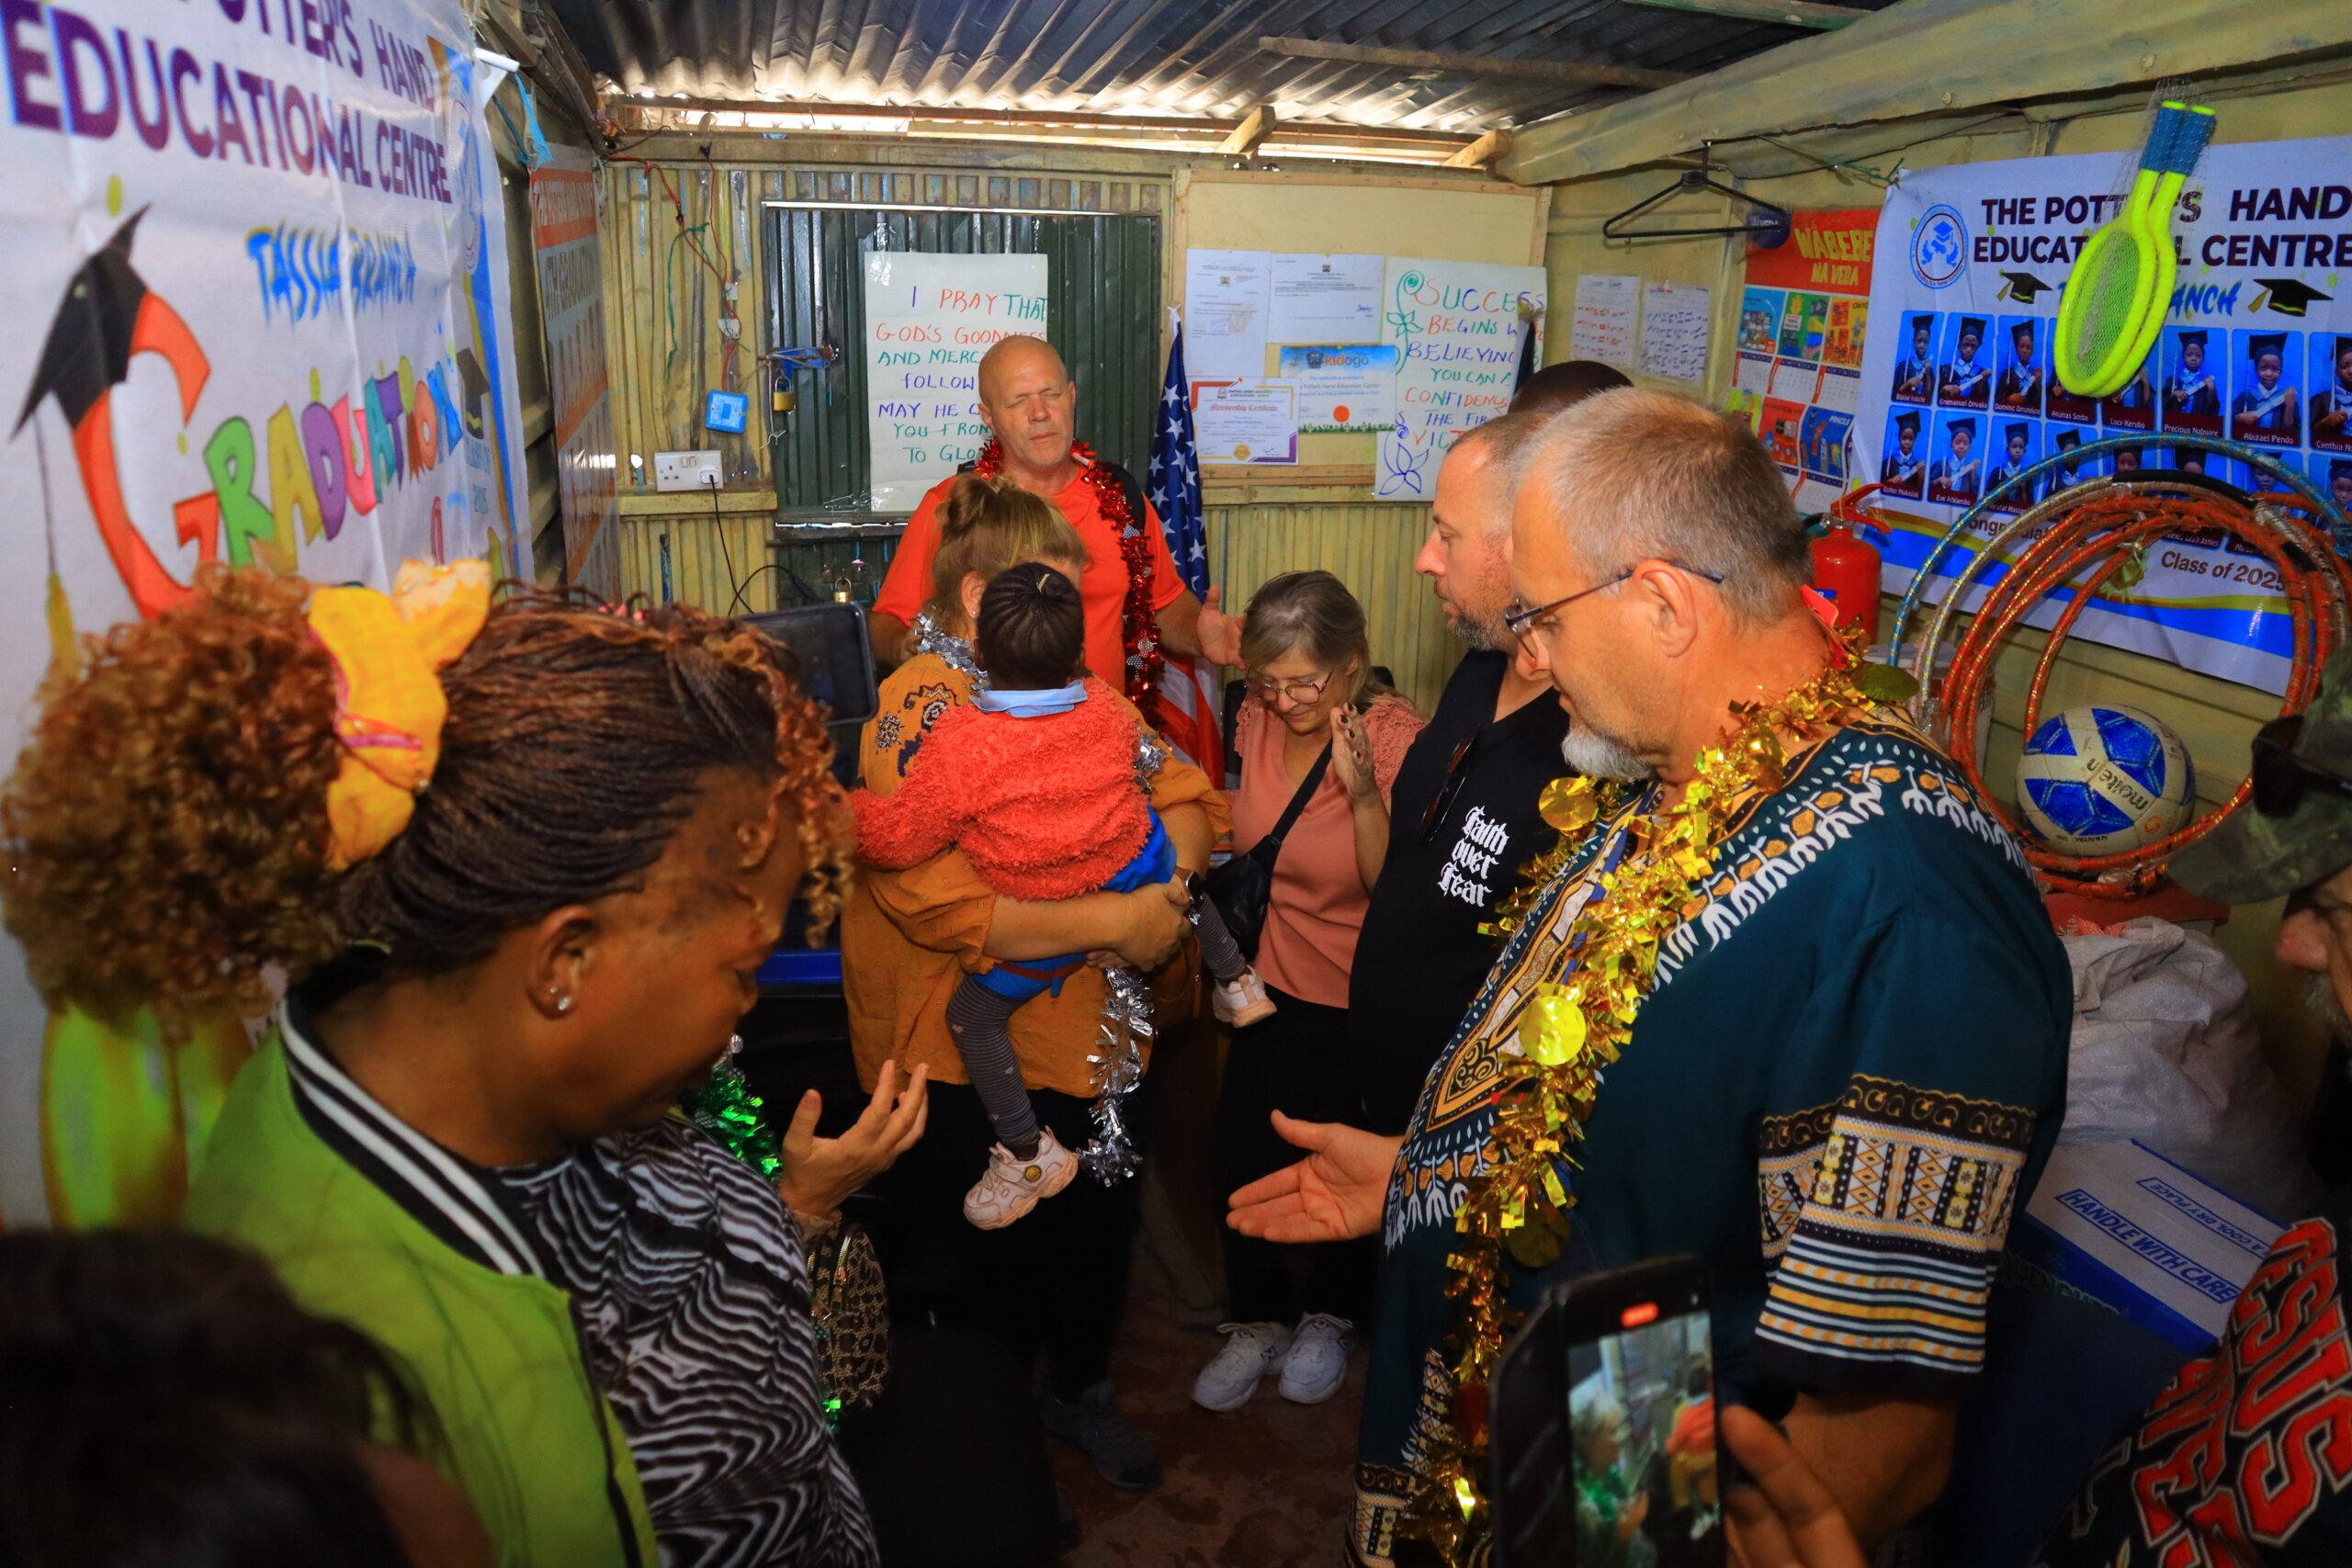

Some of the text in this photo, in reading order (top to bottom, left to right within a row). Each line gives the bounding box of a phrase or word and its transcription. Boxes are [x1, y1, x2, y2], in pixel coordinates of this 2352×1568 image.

[0, 0, 453, 204] EDUCATIONAL CENTRE
[1982, 197, 2036, 225] THE
[2229, 186, 2352, 221] HAND
[1794, 228, 1874, 262] WABEBE
[2202, 234, 2352, 266] CENTRE
[911, 286, 1047, 321] I PRAY THAT
[1415, 278, 1545, 313] SUCCESS
[876, 323, 943, 344] GOD'S
[1427, 315, 1498, 335] BEGINS
[877, 348, 987, 367] AND MERC
[1325, 355, 1369, 367] kidogo
[1430, 367, 1462, 382] YOU
[1464, 370, 1497, 386] CAN
[878, 402, 921, 418] MAY
[934, 404, 959, 418] HE
[1939, 399, 1967, 408] Emmanuel
[1425, 409, 1454, 426] THE
[2124, 420, 2145, 429] Kerubo
[893, 423, 928, 439] YOU
[2164, 424, 2191, 435] Precious
[2271, 434, 2294, 445] Pendo
[901, 446, 927, 463] TO
[2316, 441, 2344, 451] Cynthia
[2161, 551, 2208, 575] Class
[2211, 562, 2234, 580] of
[2086, 757, 2149, 810] molten
[1462, 806, 1510, 855] Faith
[1452, 838, 1499, 880] over
[2150, 1182, 2187, 1208] PLACE
[2189, 1205, 2216, 1224] DRY
[2217, 1223, 2252, 1246] COOL
[2065, 1193, 2240, 1302] HANDLE WITH CARE
